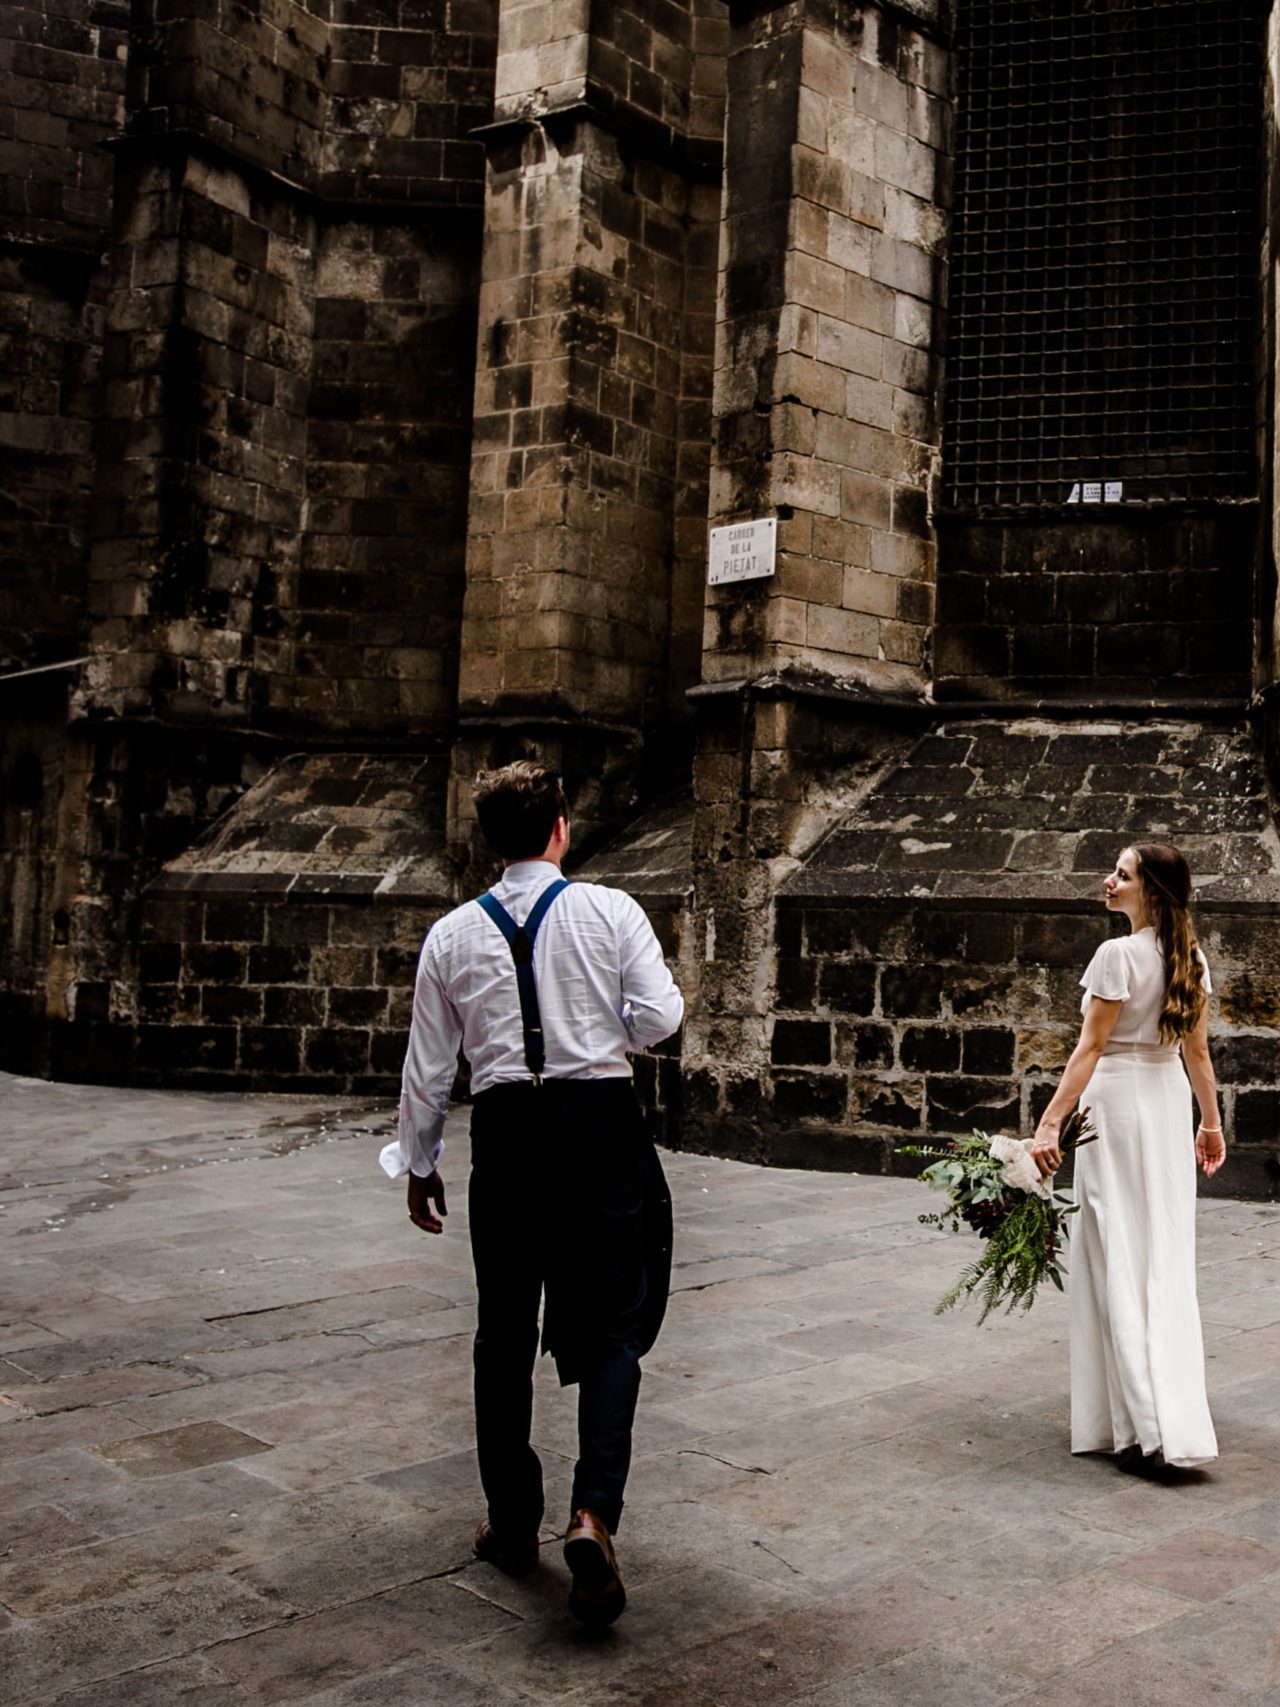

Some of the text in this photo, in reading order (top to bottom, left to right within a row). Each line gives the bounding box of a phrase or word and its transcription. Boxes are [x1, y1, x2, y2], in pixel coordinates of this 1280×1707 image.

[728, 527, 755, 541] CARRER
[731, 541, 751, 555] DE LA
[723, 555, 757, 575] PIETAT
